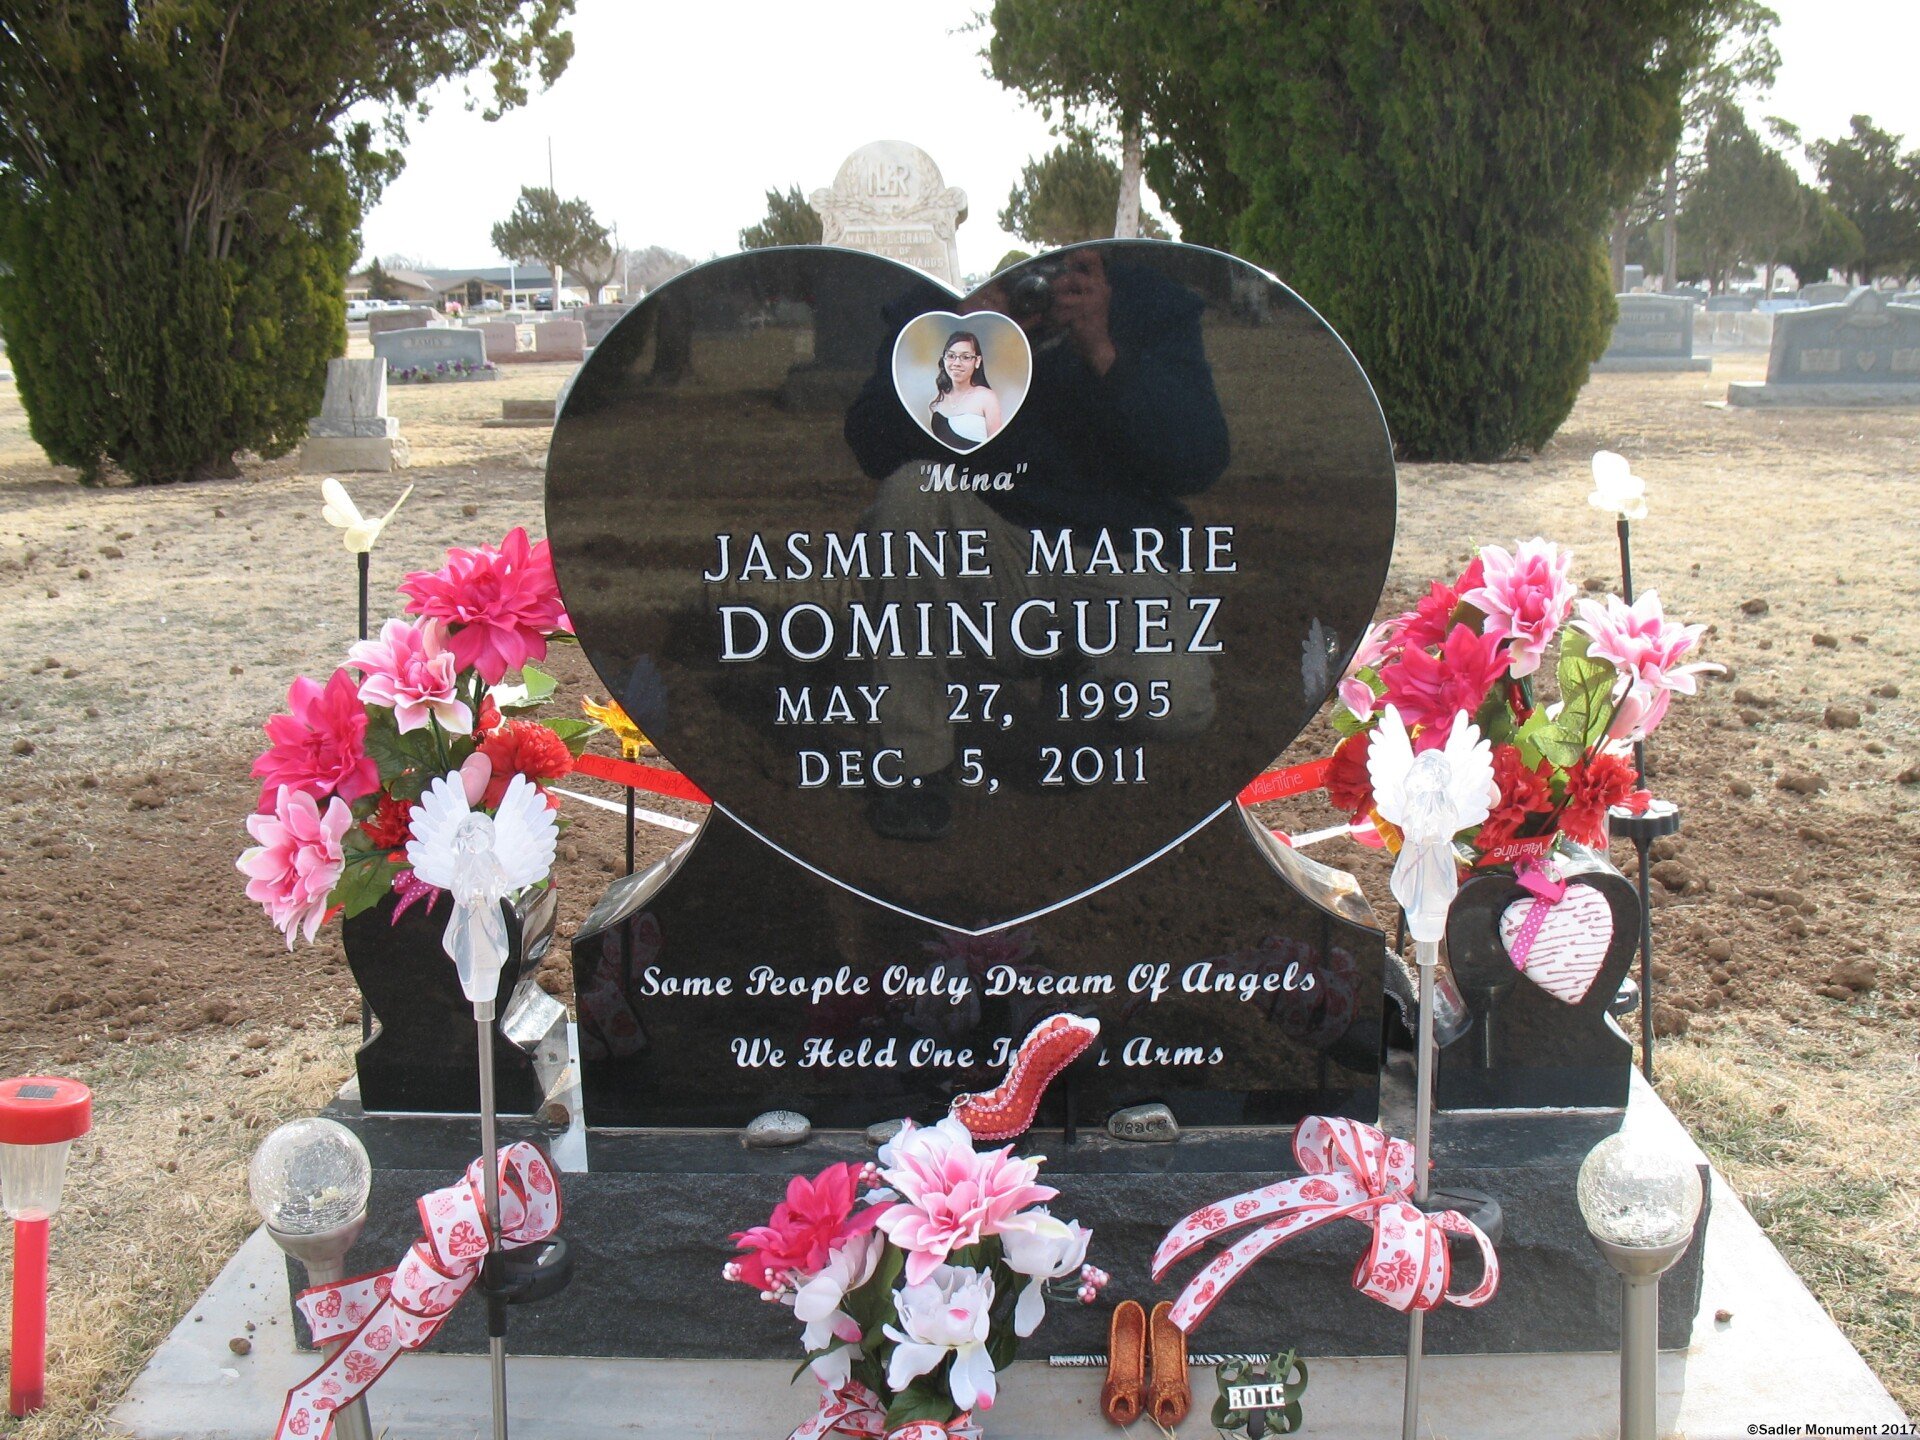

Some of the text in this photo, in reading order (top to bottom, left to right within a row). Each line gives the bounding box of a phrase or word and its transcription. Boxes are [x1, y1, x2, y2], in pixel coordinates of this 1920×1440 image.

[919, 462, 1028, 493] "Mina"
[703, 526, 1238, 582] JASMINE MARIE
[719, 598, 1224, 661] DOMINGUEZ
[776, 681, 1172, 728] MAY 27, 1995
[799, 746, 1147, 793] DEC. 5, 2011
[1249, 770, 1304, 796] Valentine
[1493, 841, 1546, 862] Valentine
[640, 961, 1316, 1005] Some People Only Dream Of Angels
[730, 1037, 786, 1068] We
[797, 1037, 898, 1068] Held
[909, 1038, 974, 1068] One
[1122, 1036, 1224, 1067] Arms
[1112, 1119, 1168, 1136] peace
[1229, 1386, 1286, 1408] ROTC
